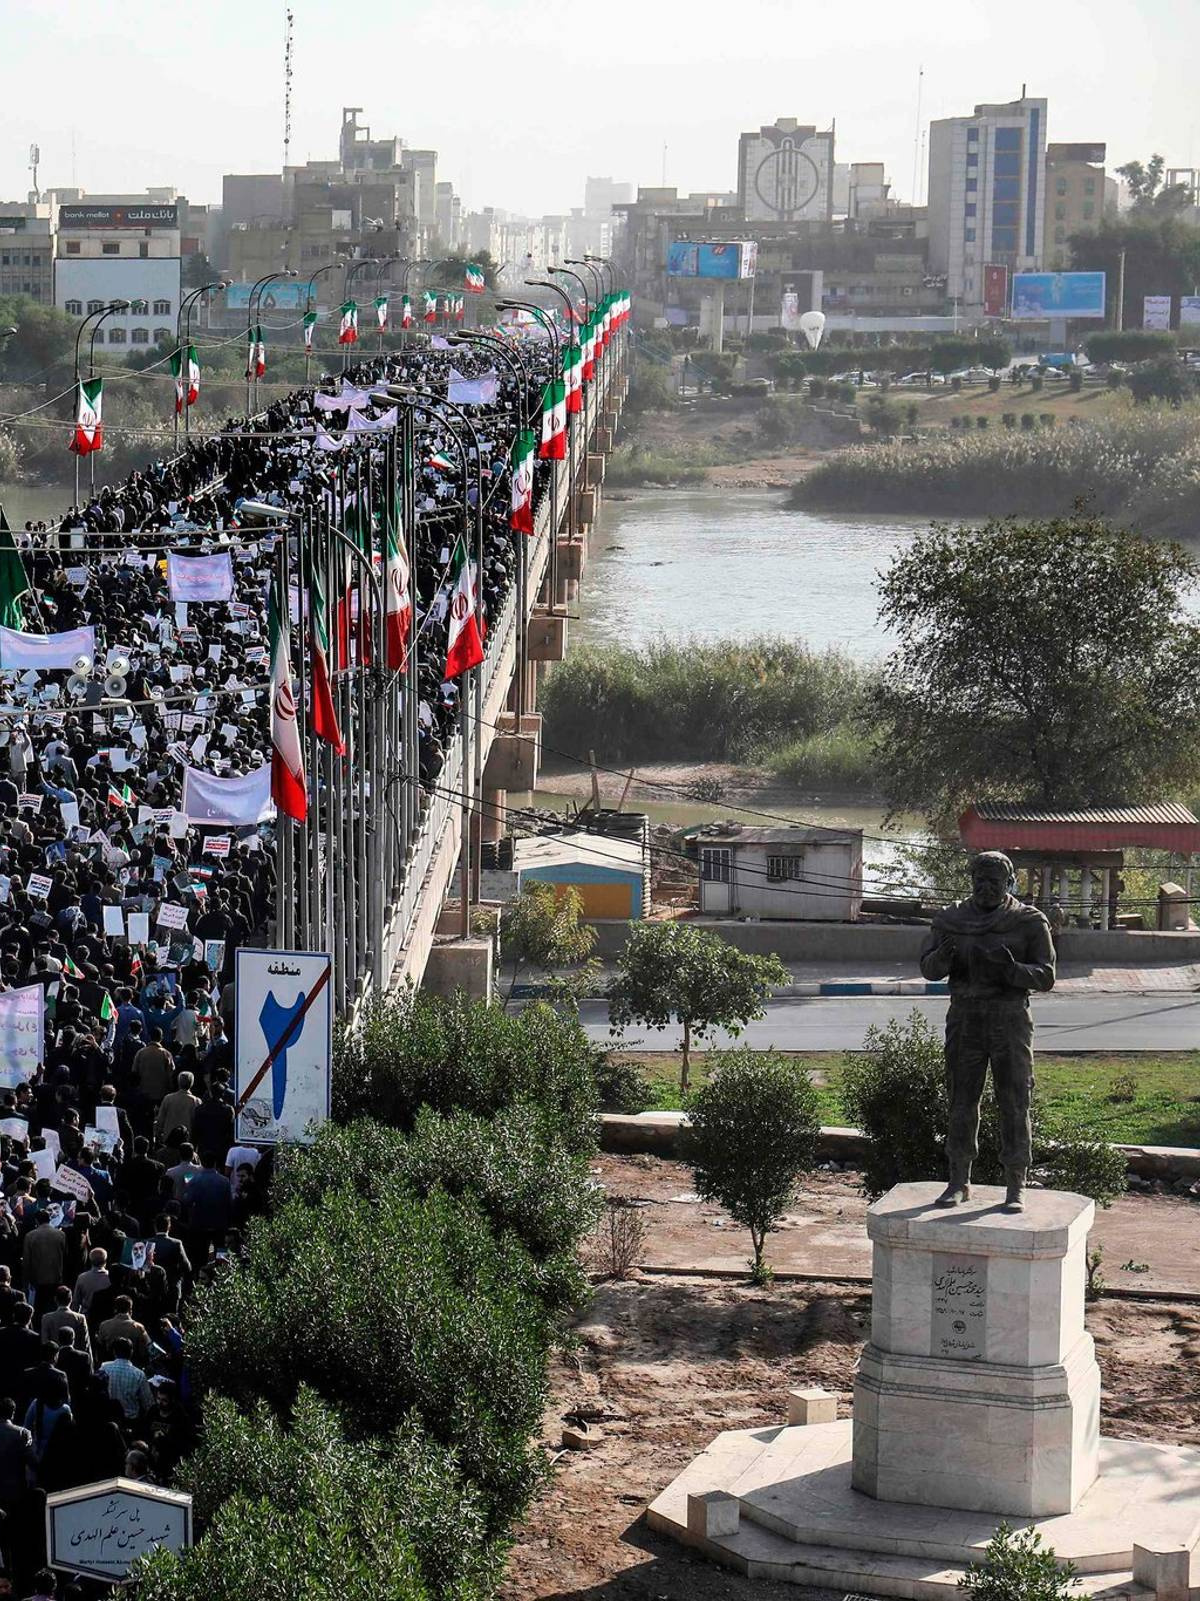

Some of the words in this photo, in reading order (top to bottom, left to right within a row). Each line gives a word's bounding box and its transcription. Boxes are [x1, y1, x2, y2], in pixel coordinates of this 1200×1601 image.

[128, 209, 152, 219] ملت
[153, 209, 174, 221] بانک
[267, 961, 301, 976] منطقه
[949, 1280, 973, 1296] حسین
[129, 1507, 141, 1522] پل
[70, 1527, 103, 1547] الهدی
[100, 1525, 119, 1555] علم
[117, 1527, 145, 1550] حسین
[146, 1524, 171, 1543] شهید
